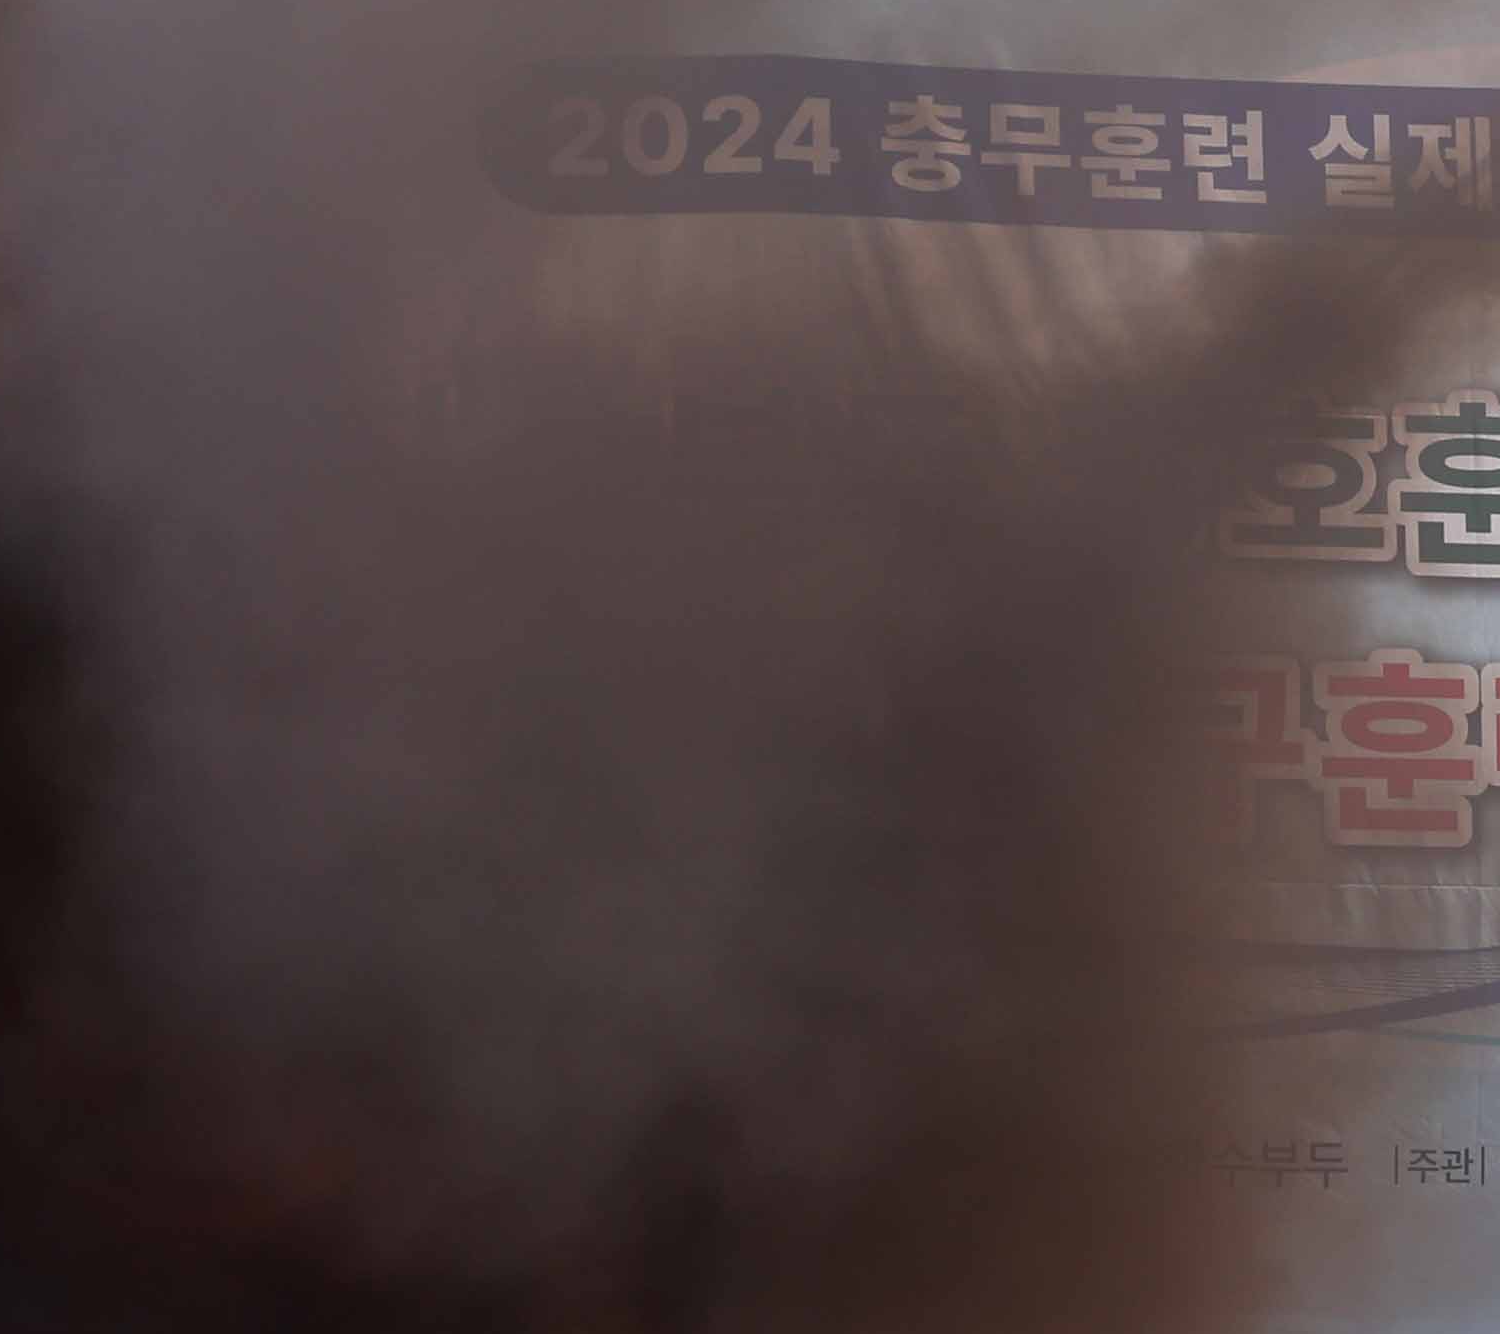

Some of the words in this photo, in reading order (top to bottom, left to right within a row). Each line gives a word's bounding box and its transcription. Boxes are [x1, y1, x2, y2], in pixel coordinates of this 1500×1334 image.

[548, 94, 842, 178] 2024
[879, 94, 1268, 204] 충무훈련
[1210, 1139, 1349, 1190] 수부두
